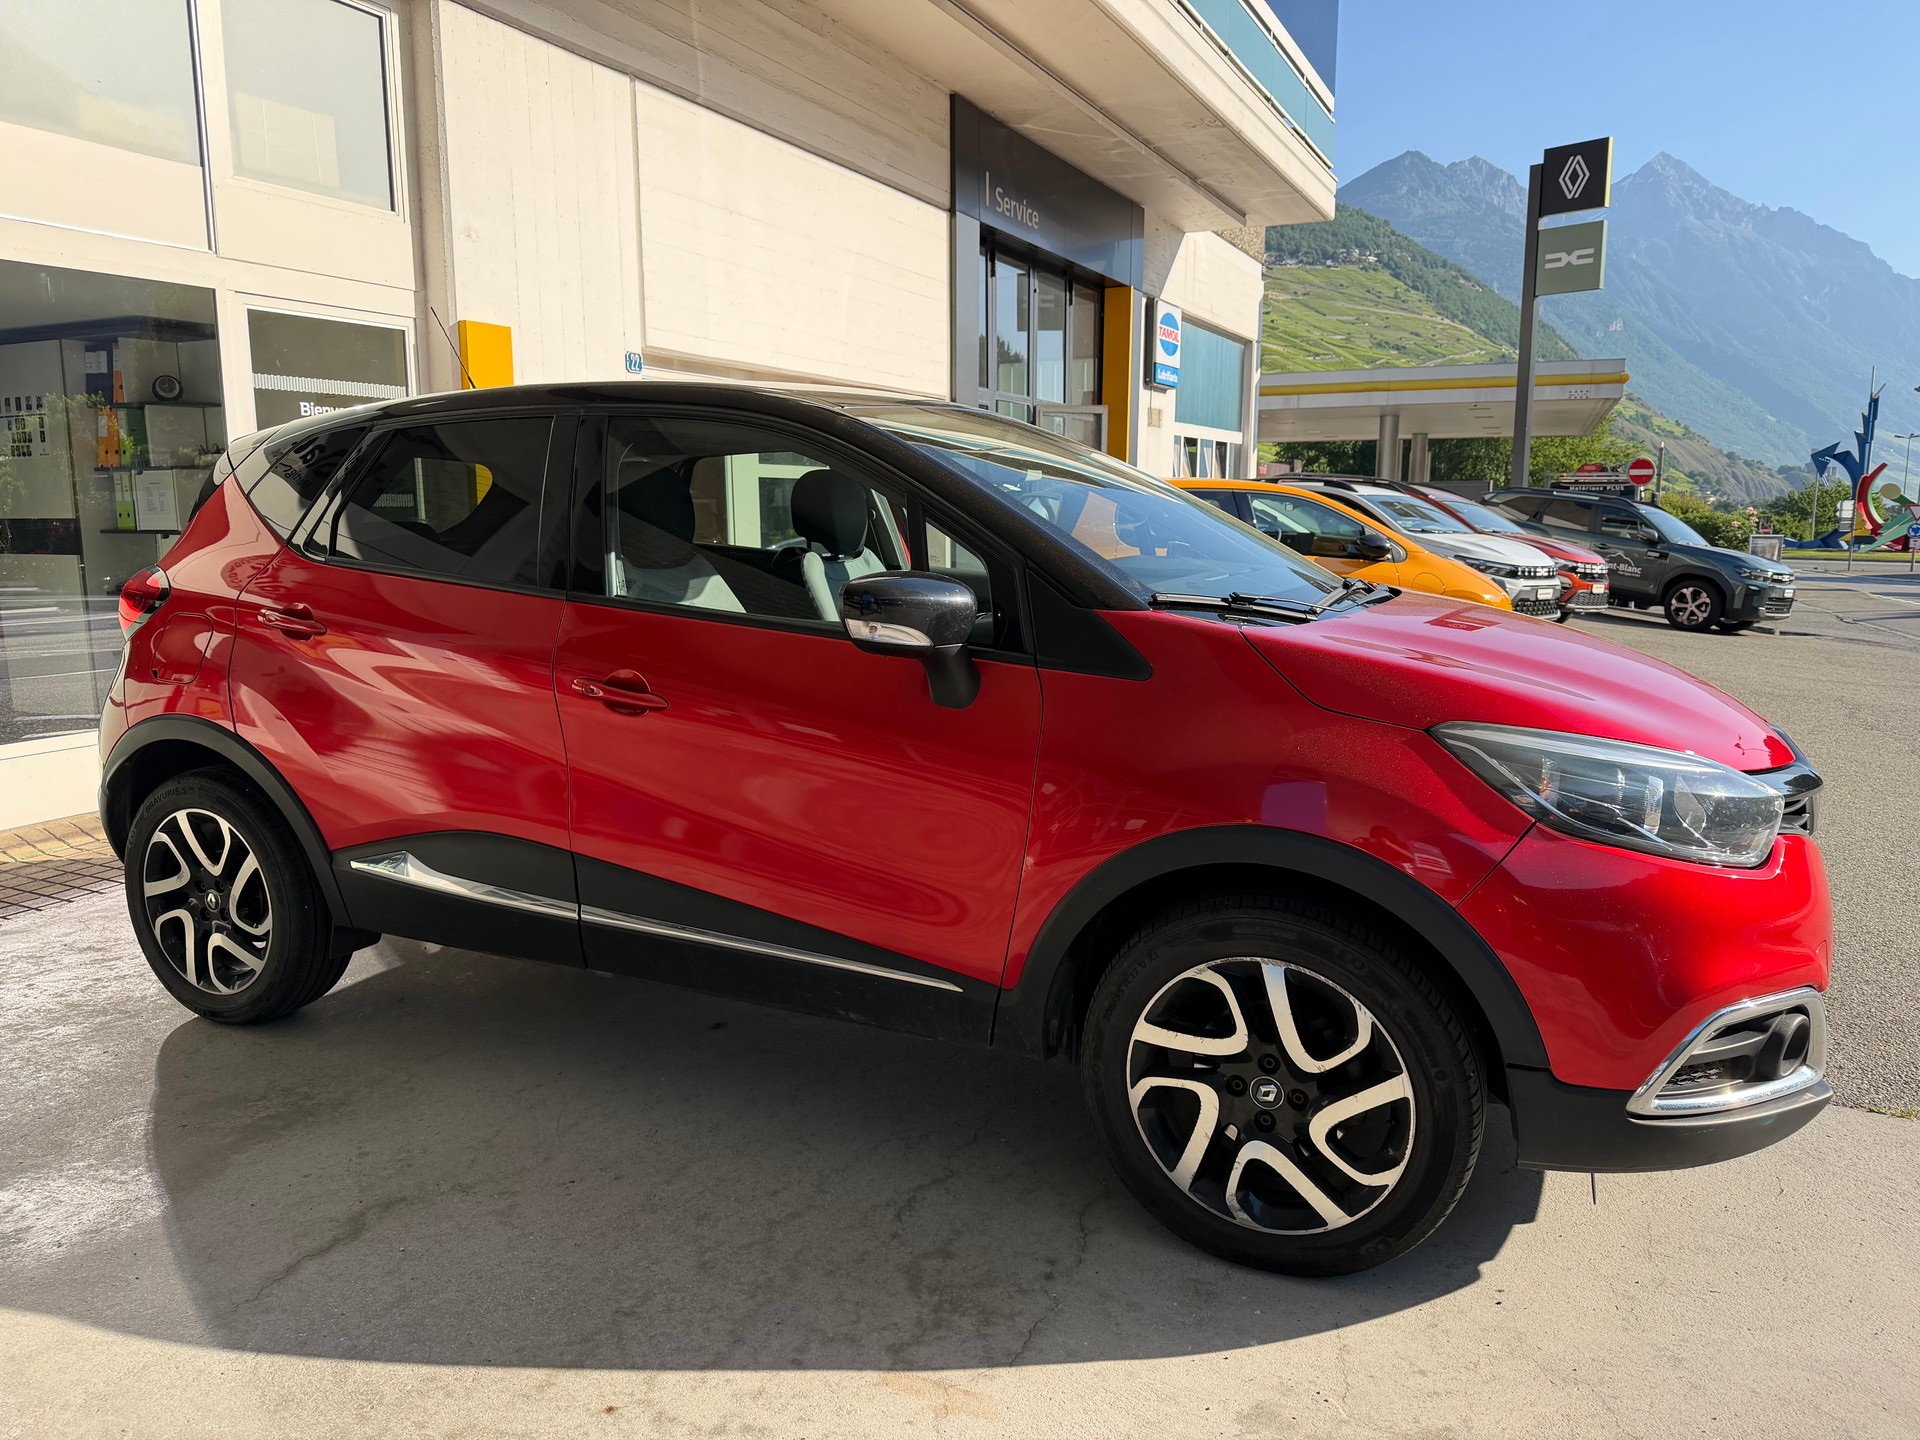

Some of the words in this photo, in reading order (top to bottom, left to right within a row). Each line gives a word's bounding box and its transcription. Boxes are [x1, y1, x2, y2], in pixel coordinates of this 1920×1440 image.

[995, 187, 1039, 229] Service
[1159, 326, 1179, 343] TAMOIL
[630, 353, 641, 371] 22
